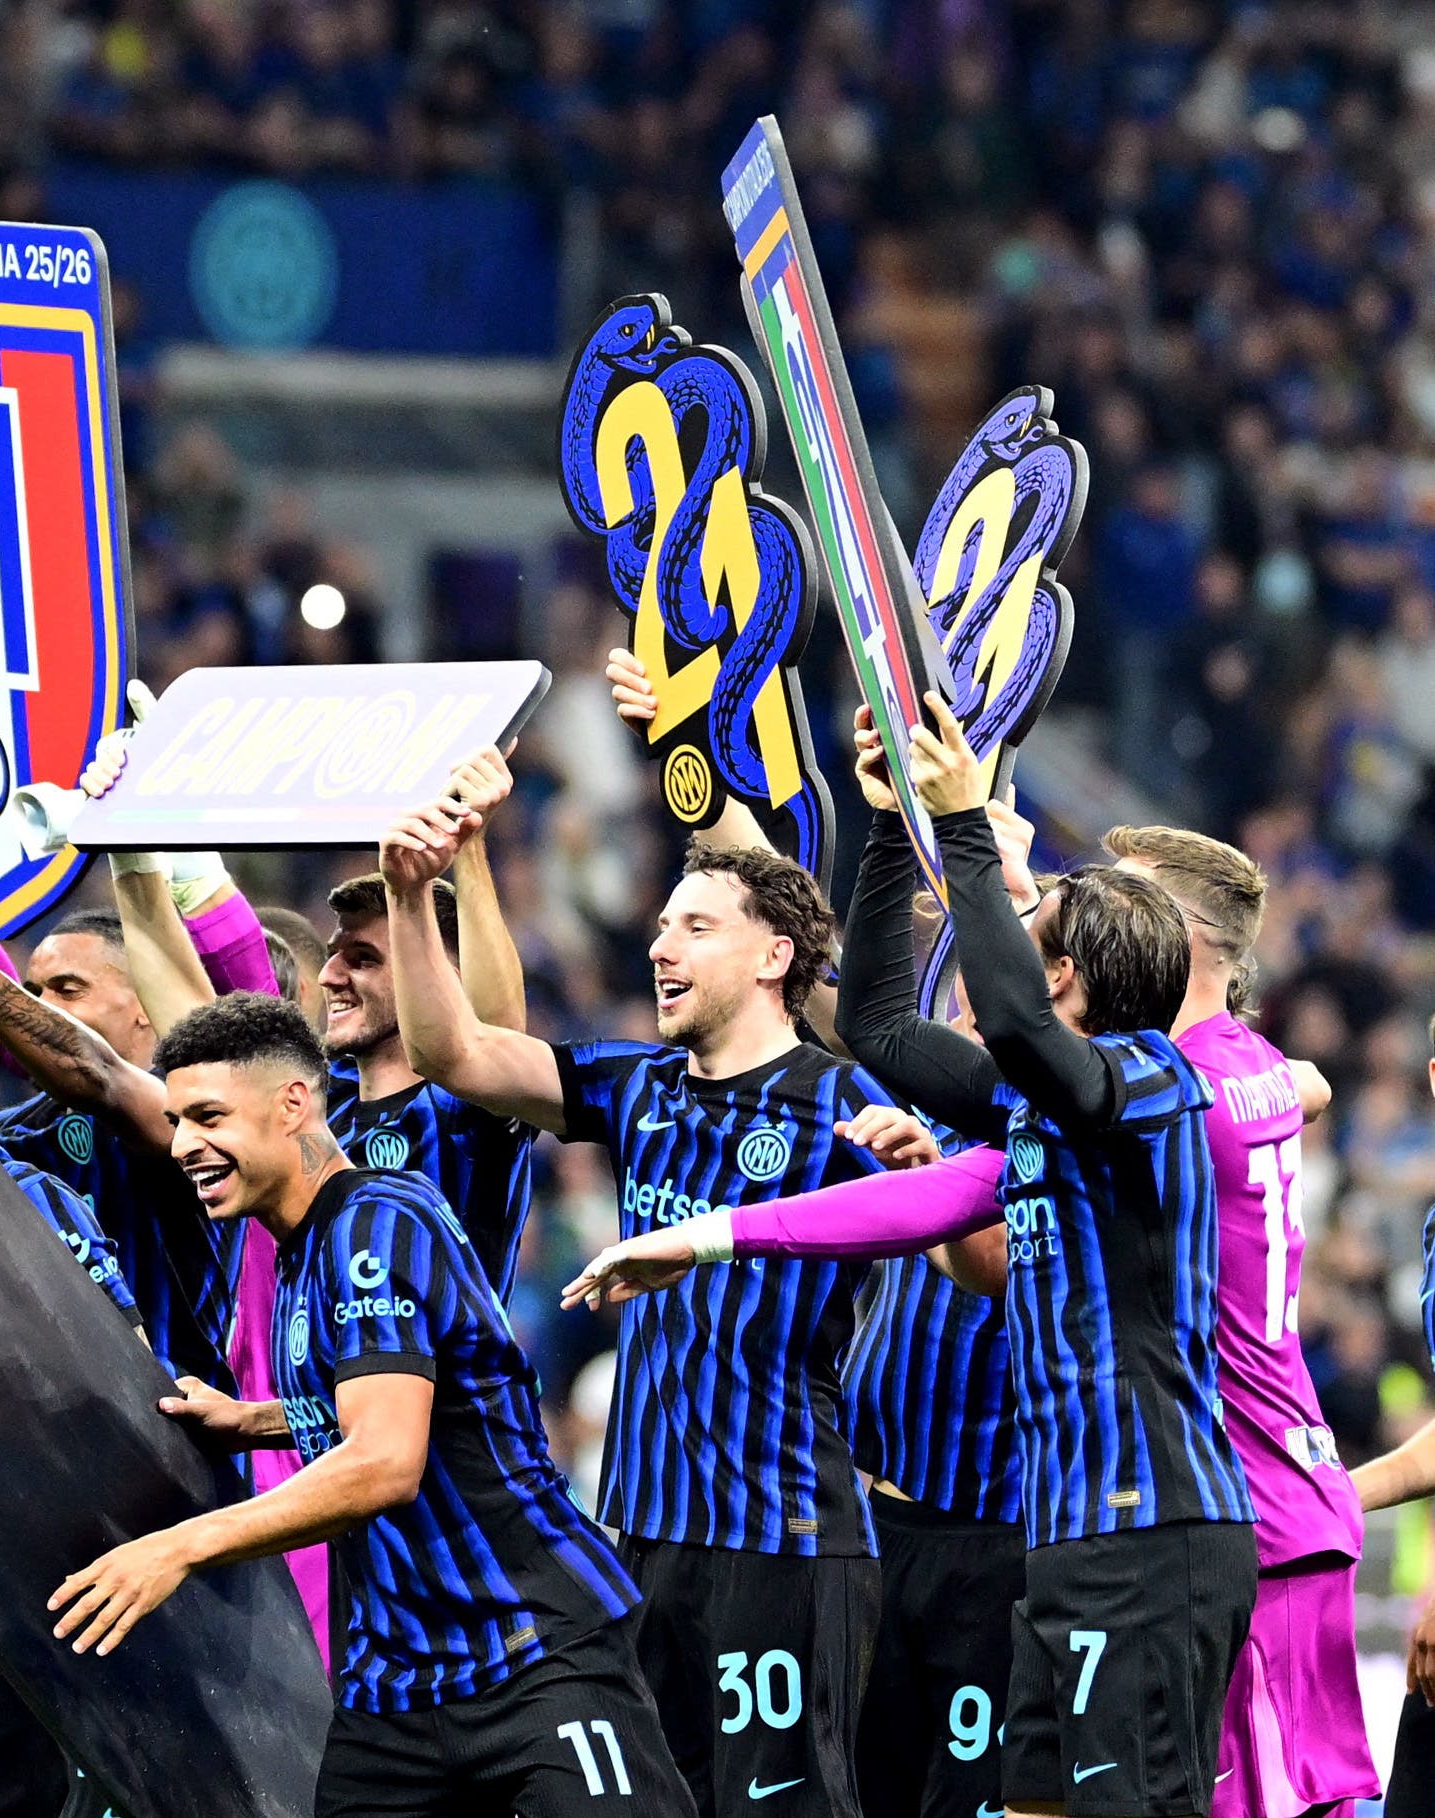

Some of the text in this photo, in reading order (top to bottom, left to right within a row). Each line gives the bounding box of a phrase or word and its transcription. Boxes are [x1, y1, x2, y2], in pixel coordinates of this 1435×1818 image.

[24, 244, 92, 289] 25/26
[333, 1296, 416, 1325] Gate.io
[717, 1649, 803, 1735] 30
[1069, 1630, 1107, 1715] 7
[557, 1719, 633, 1797] 11
[947, 1684, 1006, 1761] 9
